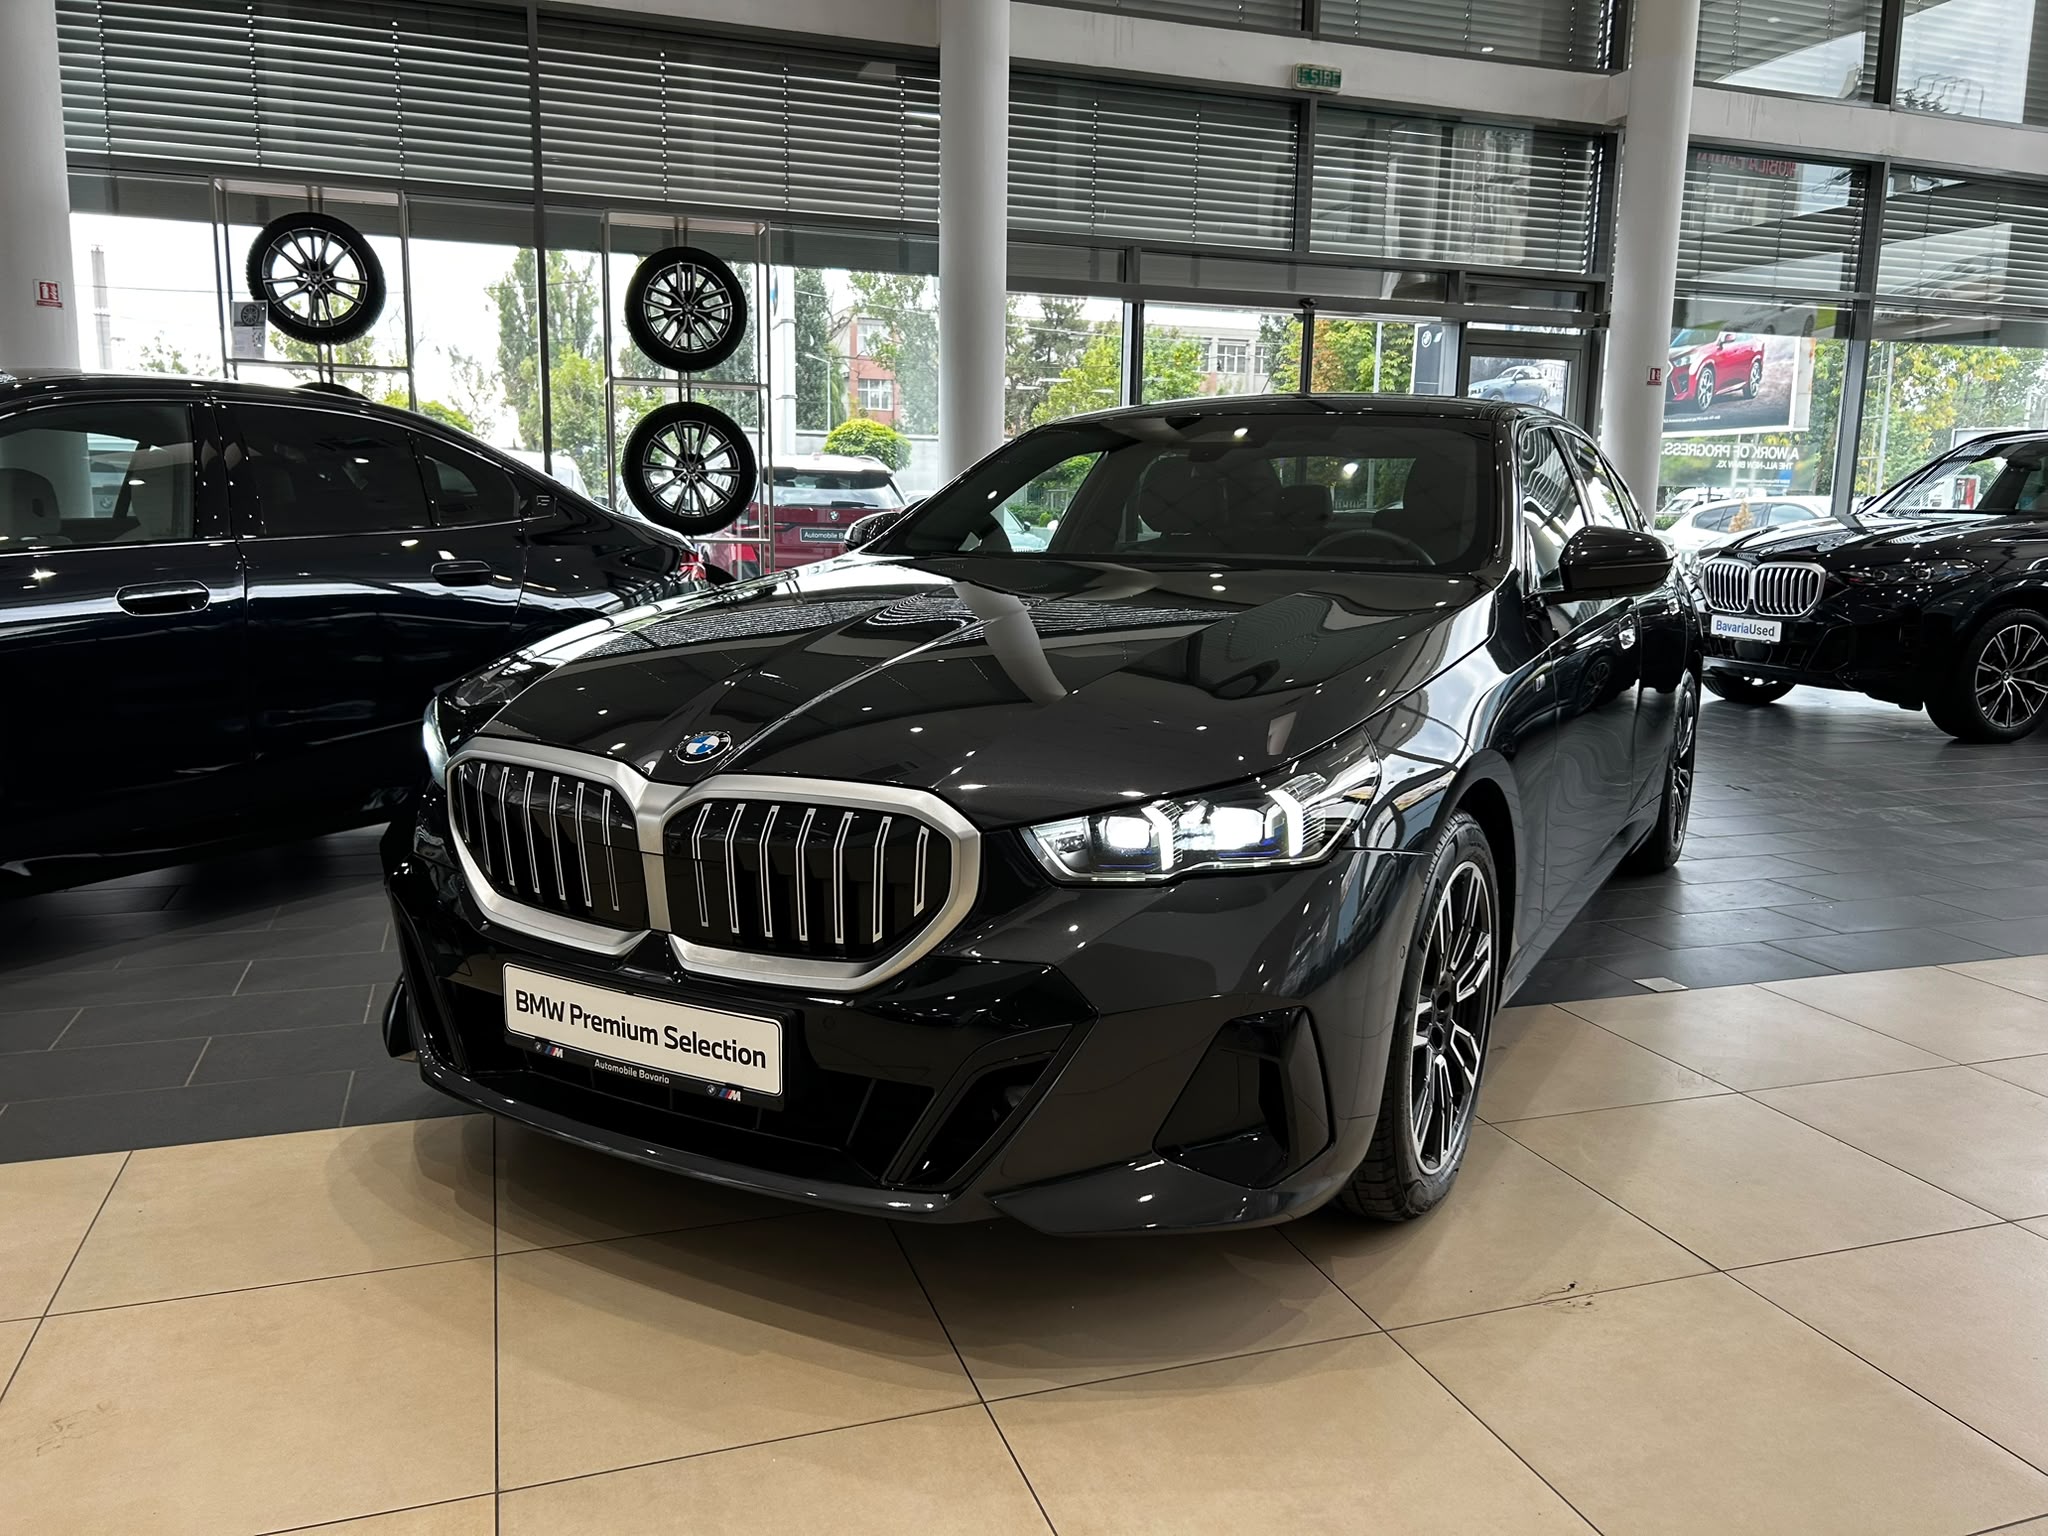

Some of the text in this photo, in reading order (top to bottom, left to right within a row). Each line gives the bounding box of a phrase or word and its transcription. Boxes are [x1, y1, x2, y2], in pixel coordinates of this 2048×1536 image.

[804, 531, 837, 539] Automobile
[1716, 619, 1775, 637] BavariaUsed
[515, 989, 767, 1069] BMW Premium Selection
[594, 1058, 670, 1084] Automobile Bavaria
